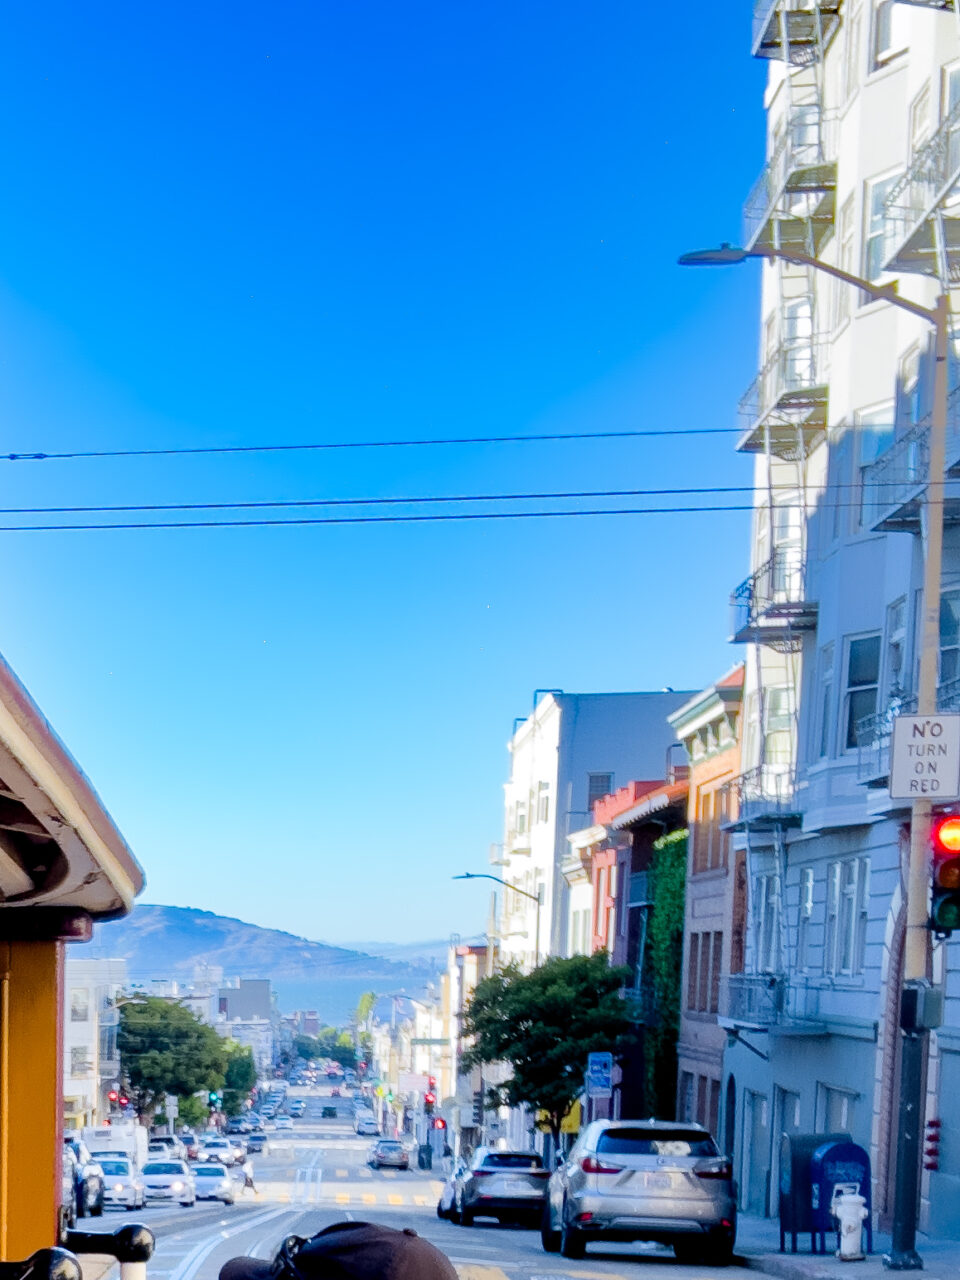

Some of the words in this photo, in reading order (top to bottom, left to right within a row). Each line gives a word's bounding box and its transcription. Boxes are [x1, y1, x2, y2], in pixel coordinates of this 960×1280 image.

[912, 721, 944, 739] NO
[907, 743, 948, 757] TURN
[914, 760, 938, 775] ON
[909, 778, 941, 793] RED
